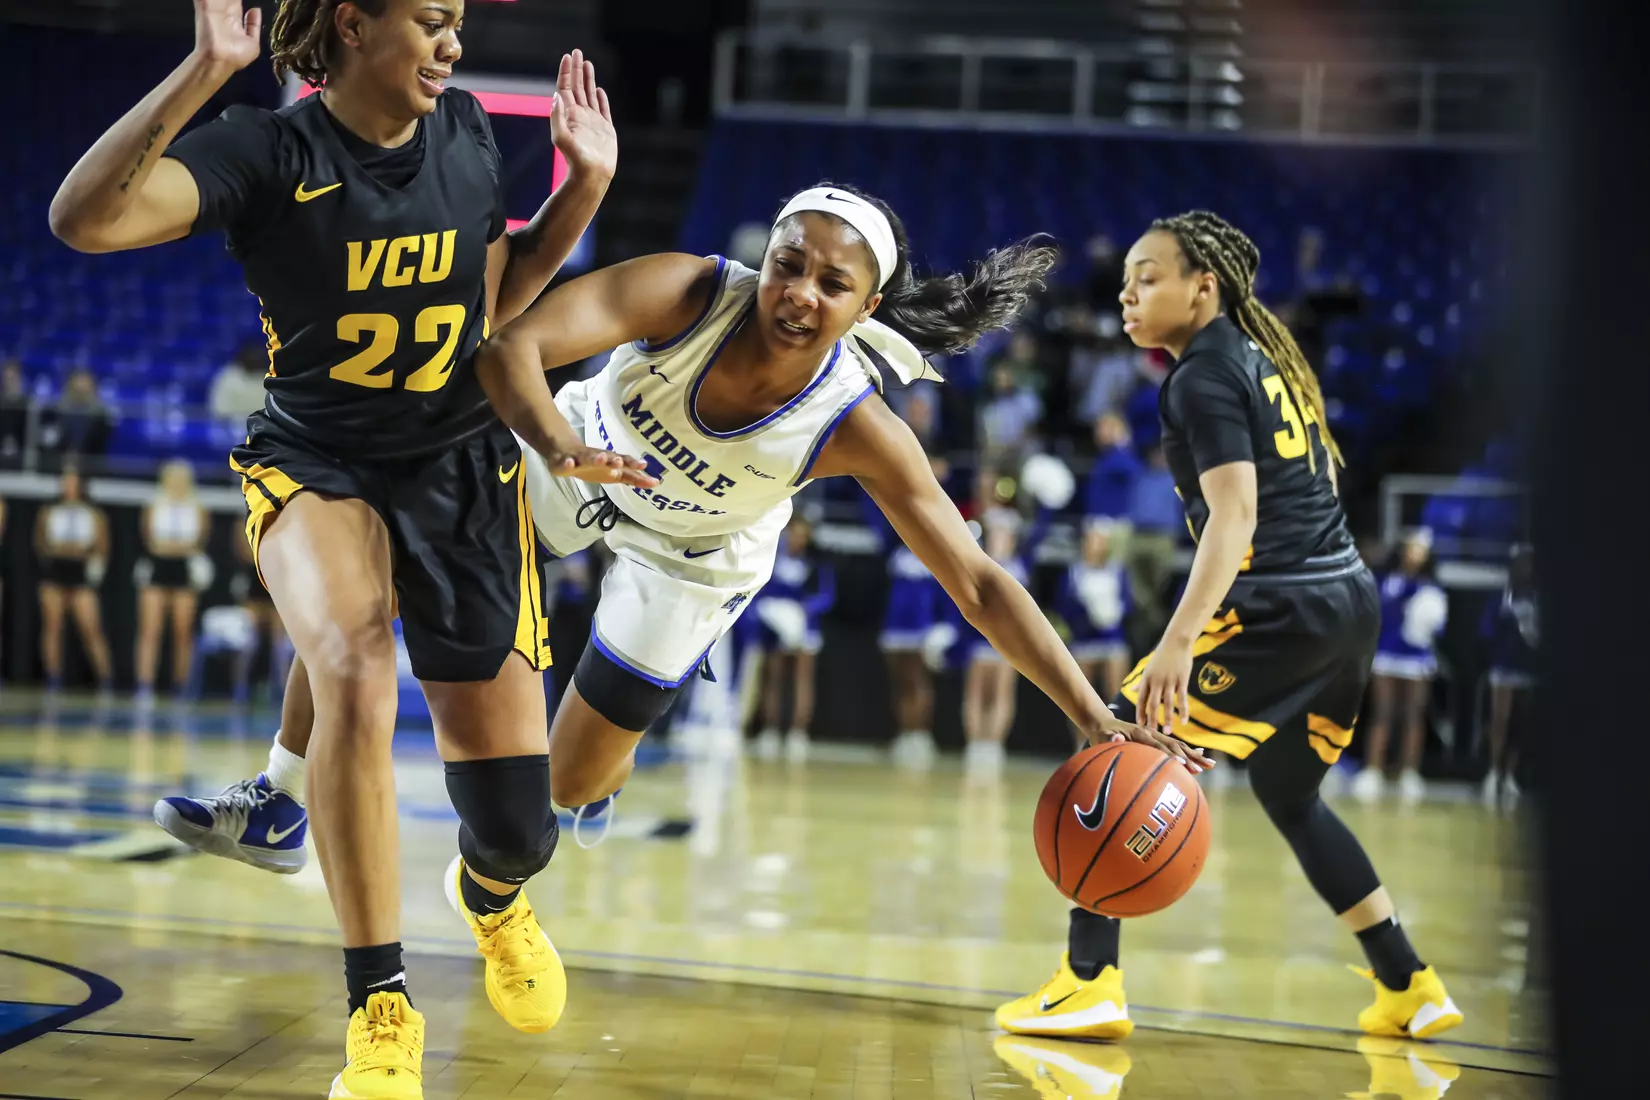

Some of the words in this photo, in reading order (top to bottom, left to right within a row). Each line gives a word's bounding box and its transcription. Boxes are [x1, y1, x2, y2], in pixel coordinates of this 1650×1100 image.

[346, 229, 458, 292] VCU
[329, 304, 466, 392] 22
[621, 393, 737, 498] MIDDLE
[1124, 782, 1187, 859] ELITE
